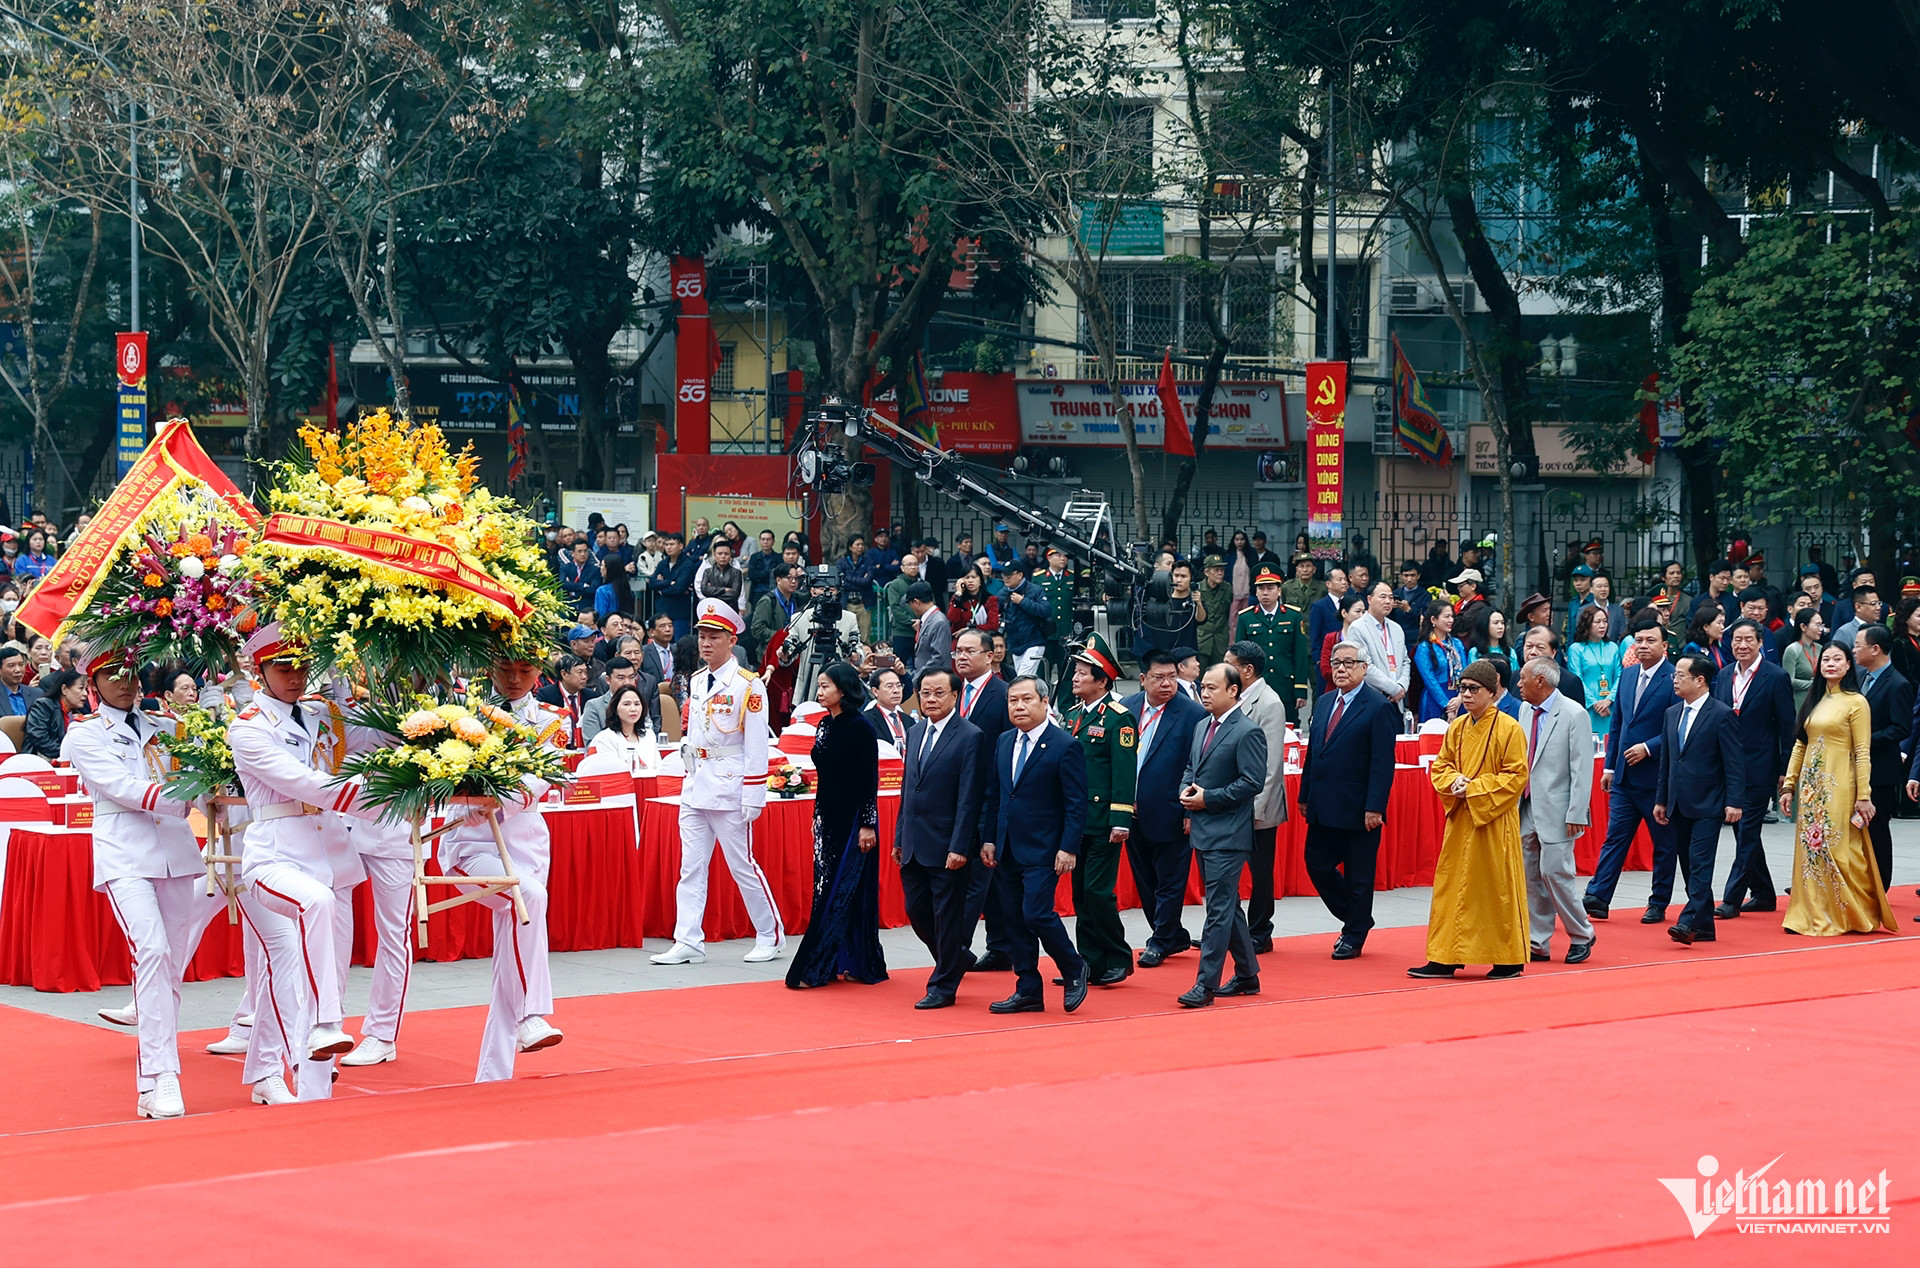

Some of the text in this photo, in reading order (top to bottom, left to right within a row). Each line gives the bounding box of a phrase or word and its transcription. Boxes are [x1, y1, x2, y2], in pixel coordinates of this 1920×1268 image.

[676, 280, 702, 297] 5G
[679, 385, 706, 402] 5G
[1051, 401, 1101, 417] TRUNG
[952, 422, 970, 432] PHỤ
[973, 421, 995, 432] KIỆN
[1475, 441, 1490, 453] 97
[63, 538, 111, 602] NGUYỄN
[108, 513, 134, 537] THỊ
[129, 474, 164, 513] TUYẾN
[320, 524, 345, 543] HĐND
[348, 529, 373, 549] UBND
[374, 533, 413, 559] UBMTTQ
[413, 543, 436, 570] VIỆT
[437, 550, 459, 573] NAM
